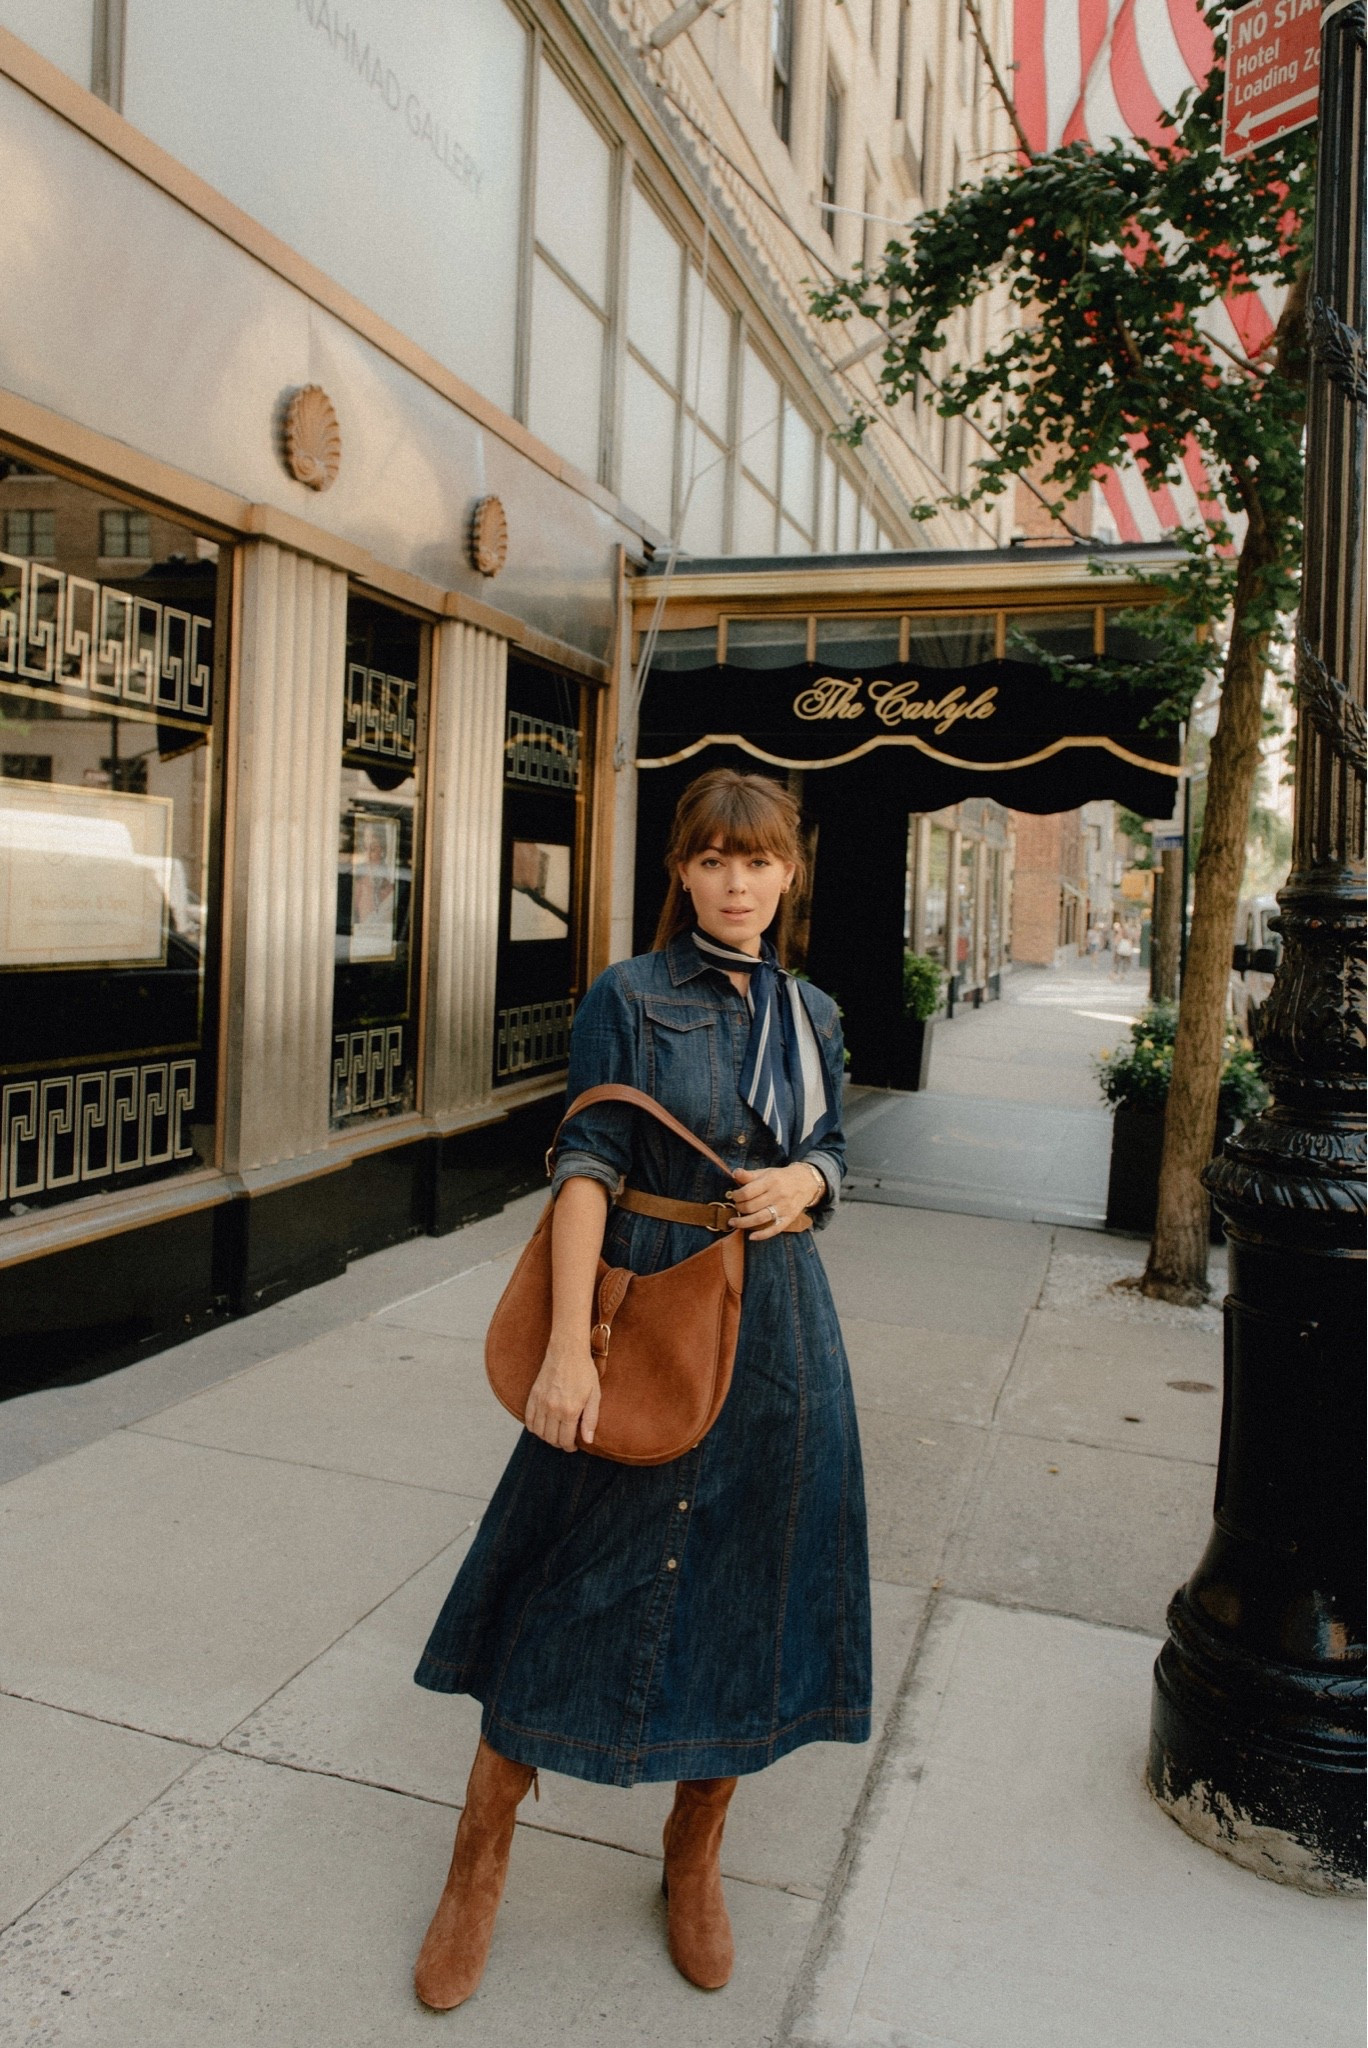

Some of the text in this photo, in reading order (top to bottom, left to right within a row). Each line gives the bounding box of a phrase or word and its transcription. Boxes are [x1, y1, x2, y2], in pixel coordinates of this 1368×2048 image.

[1238, 11, 1267, 49] NO
[1236, 37, 1280, 79] Hotel
[1234, 60, 1298, 106] Loading
[405, 94, 483, 193] GALLERY
[793, 677, 999, 735] The Carlyle
